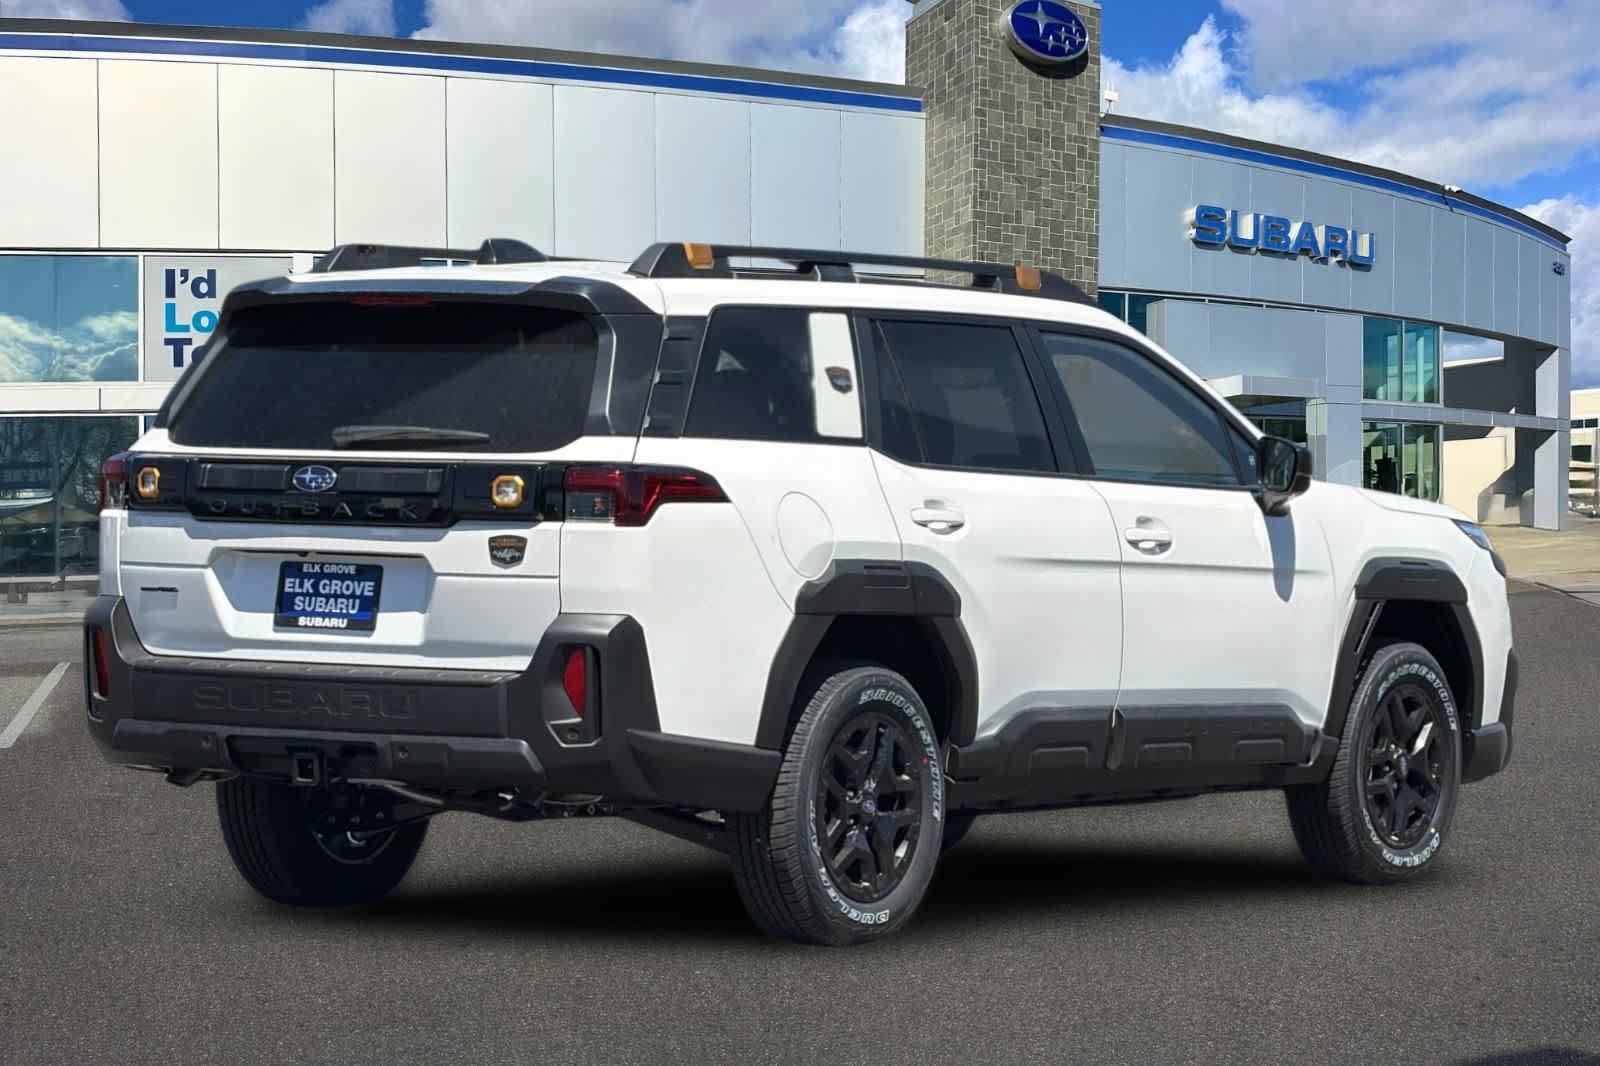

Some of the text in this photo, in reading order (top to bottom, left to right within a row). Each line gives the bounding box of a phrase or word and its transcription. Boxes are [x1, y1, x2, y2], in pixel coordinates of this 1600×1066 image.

[1193, 204, 1376, 268] SUBARU
[164, 268, 217, 299] I’d
[164, 302, 221, 333] Lo
[208, 498, 417, 519] OUTBACK
[303, 563, 357, 574] ELK GROVE
[284, 577, 375, 596] ELK GROVE
[293, 595, 360, 614] SUBARU
[298, 616, 348, 628] SUBARU
[192, 686, 417, 720] SUBARU
